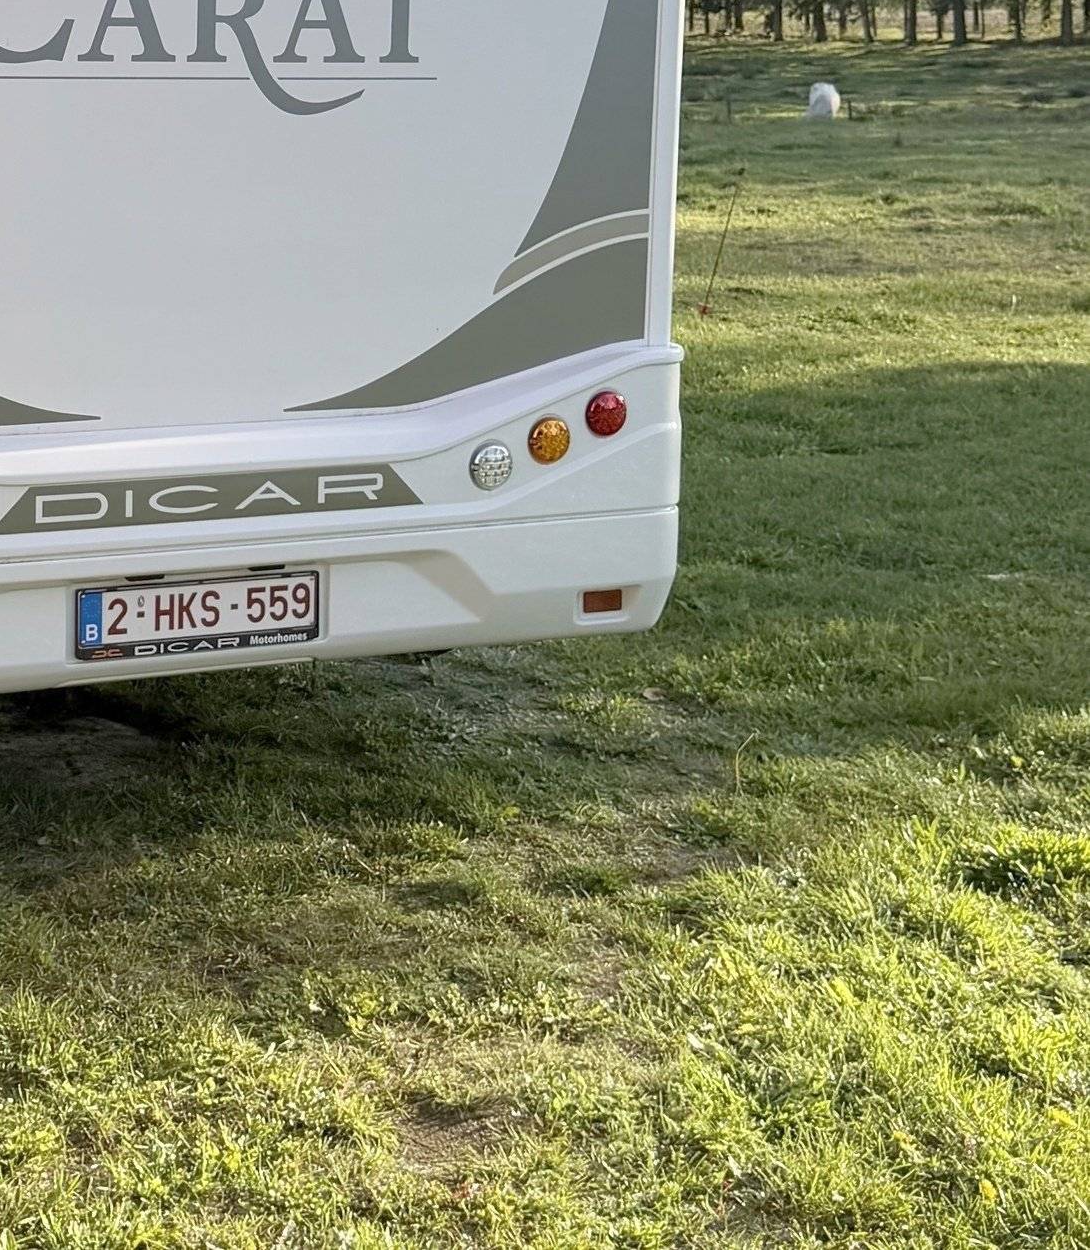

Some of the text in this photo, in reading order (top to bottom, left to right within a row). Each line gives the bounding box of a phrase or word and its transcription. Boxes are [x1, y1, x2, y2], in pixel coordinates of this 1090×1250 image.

[35, 473, 383, 524] DICAR
[85, 623, 99, 642] B
[134, 632, 308, 656] DICAR Motorhomes
